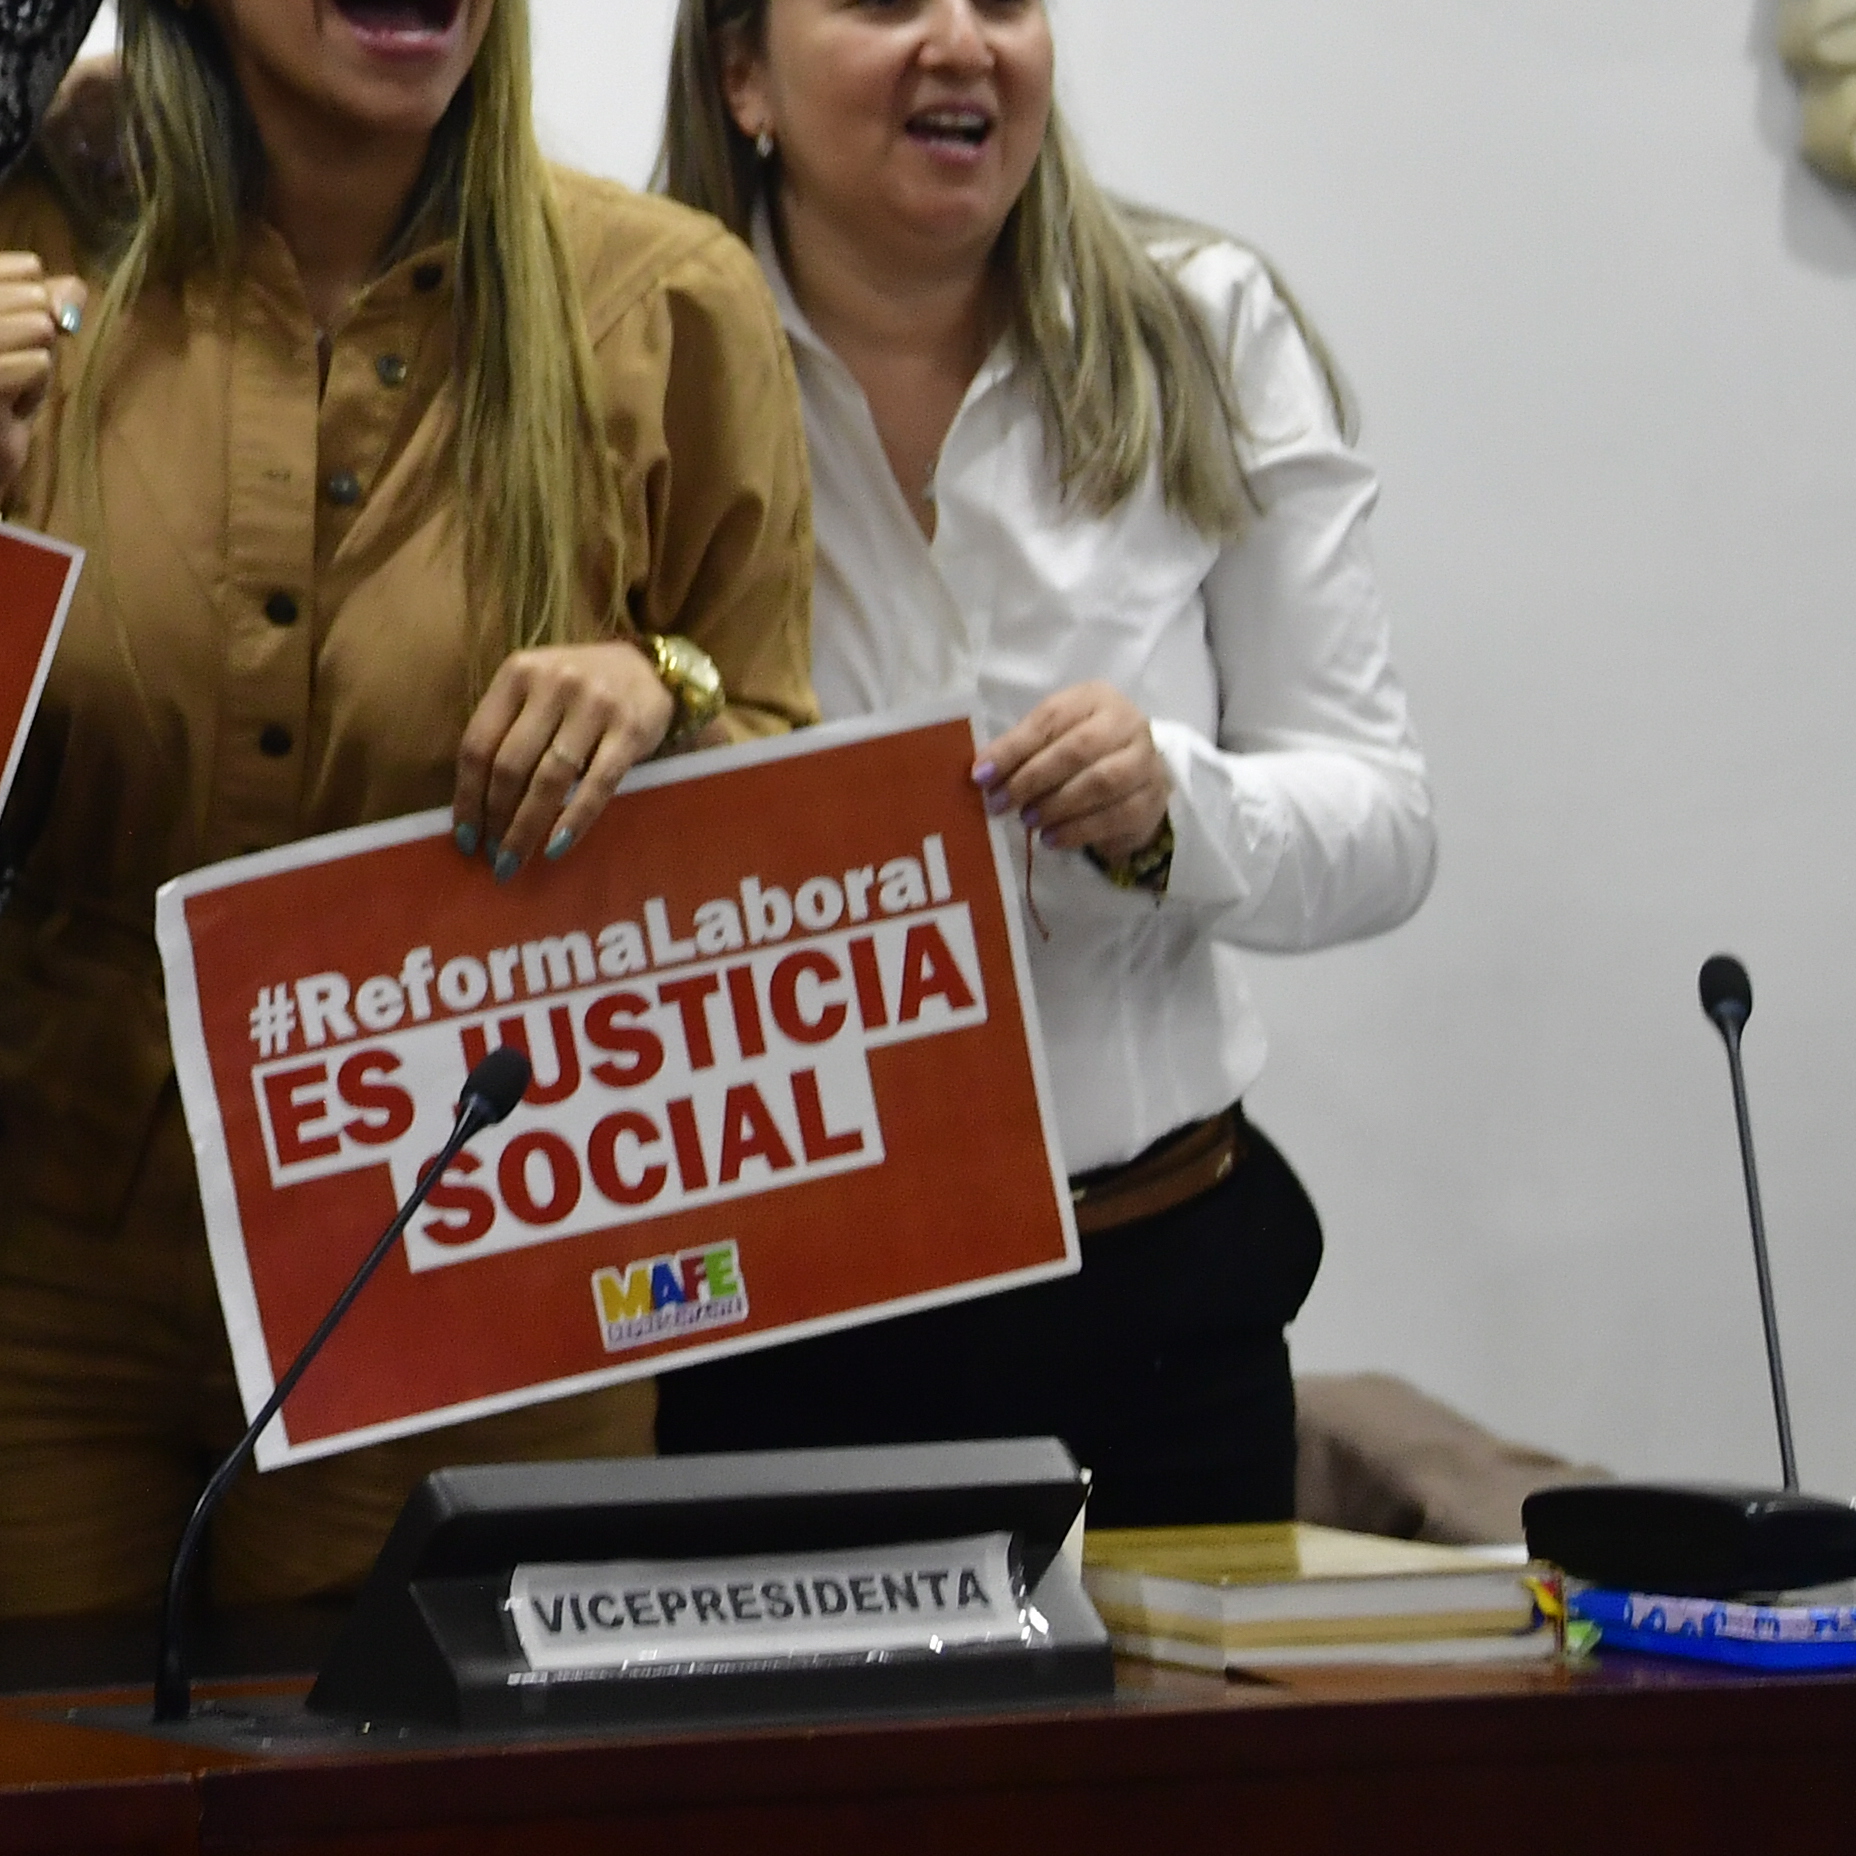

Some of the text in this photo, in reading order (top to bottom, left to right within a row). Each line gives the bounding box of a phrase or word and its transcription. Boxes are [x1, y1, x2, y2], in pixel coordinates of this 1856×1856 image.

[249, 832, 953, 1058] #ReformaLaboral
[263, 1047, 417, 1168] ES
[415, 1066, 866, 1248] SOCIAL
[599, 1248, 738, 1324] MAFE
[530, 1566, 990, 1636] VICEPRESIDENTA
